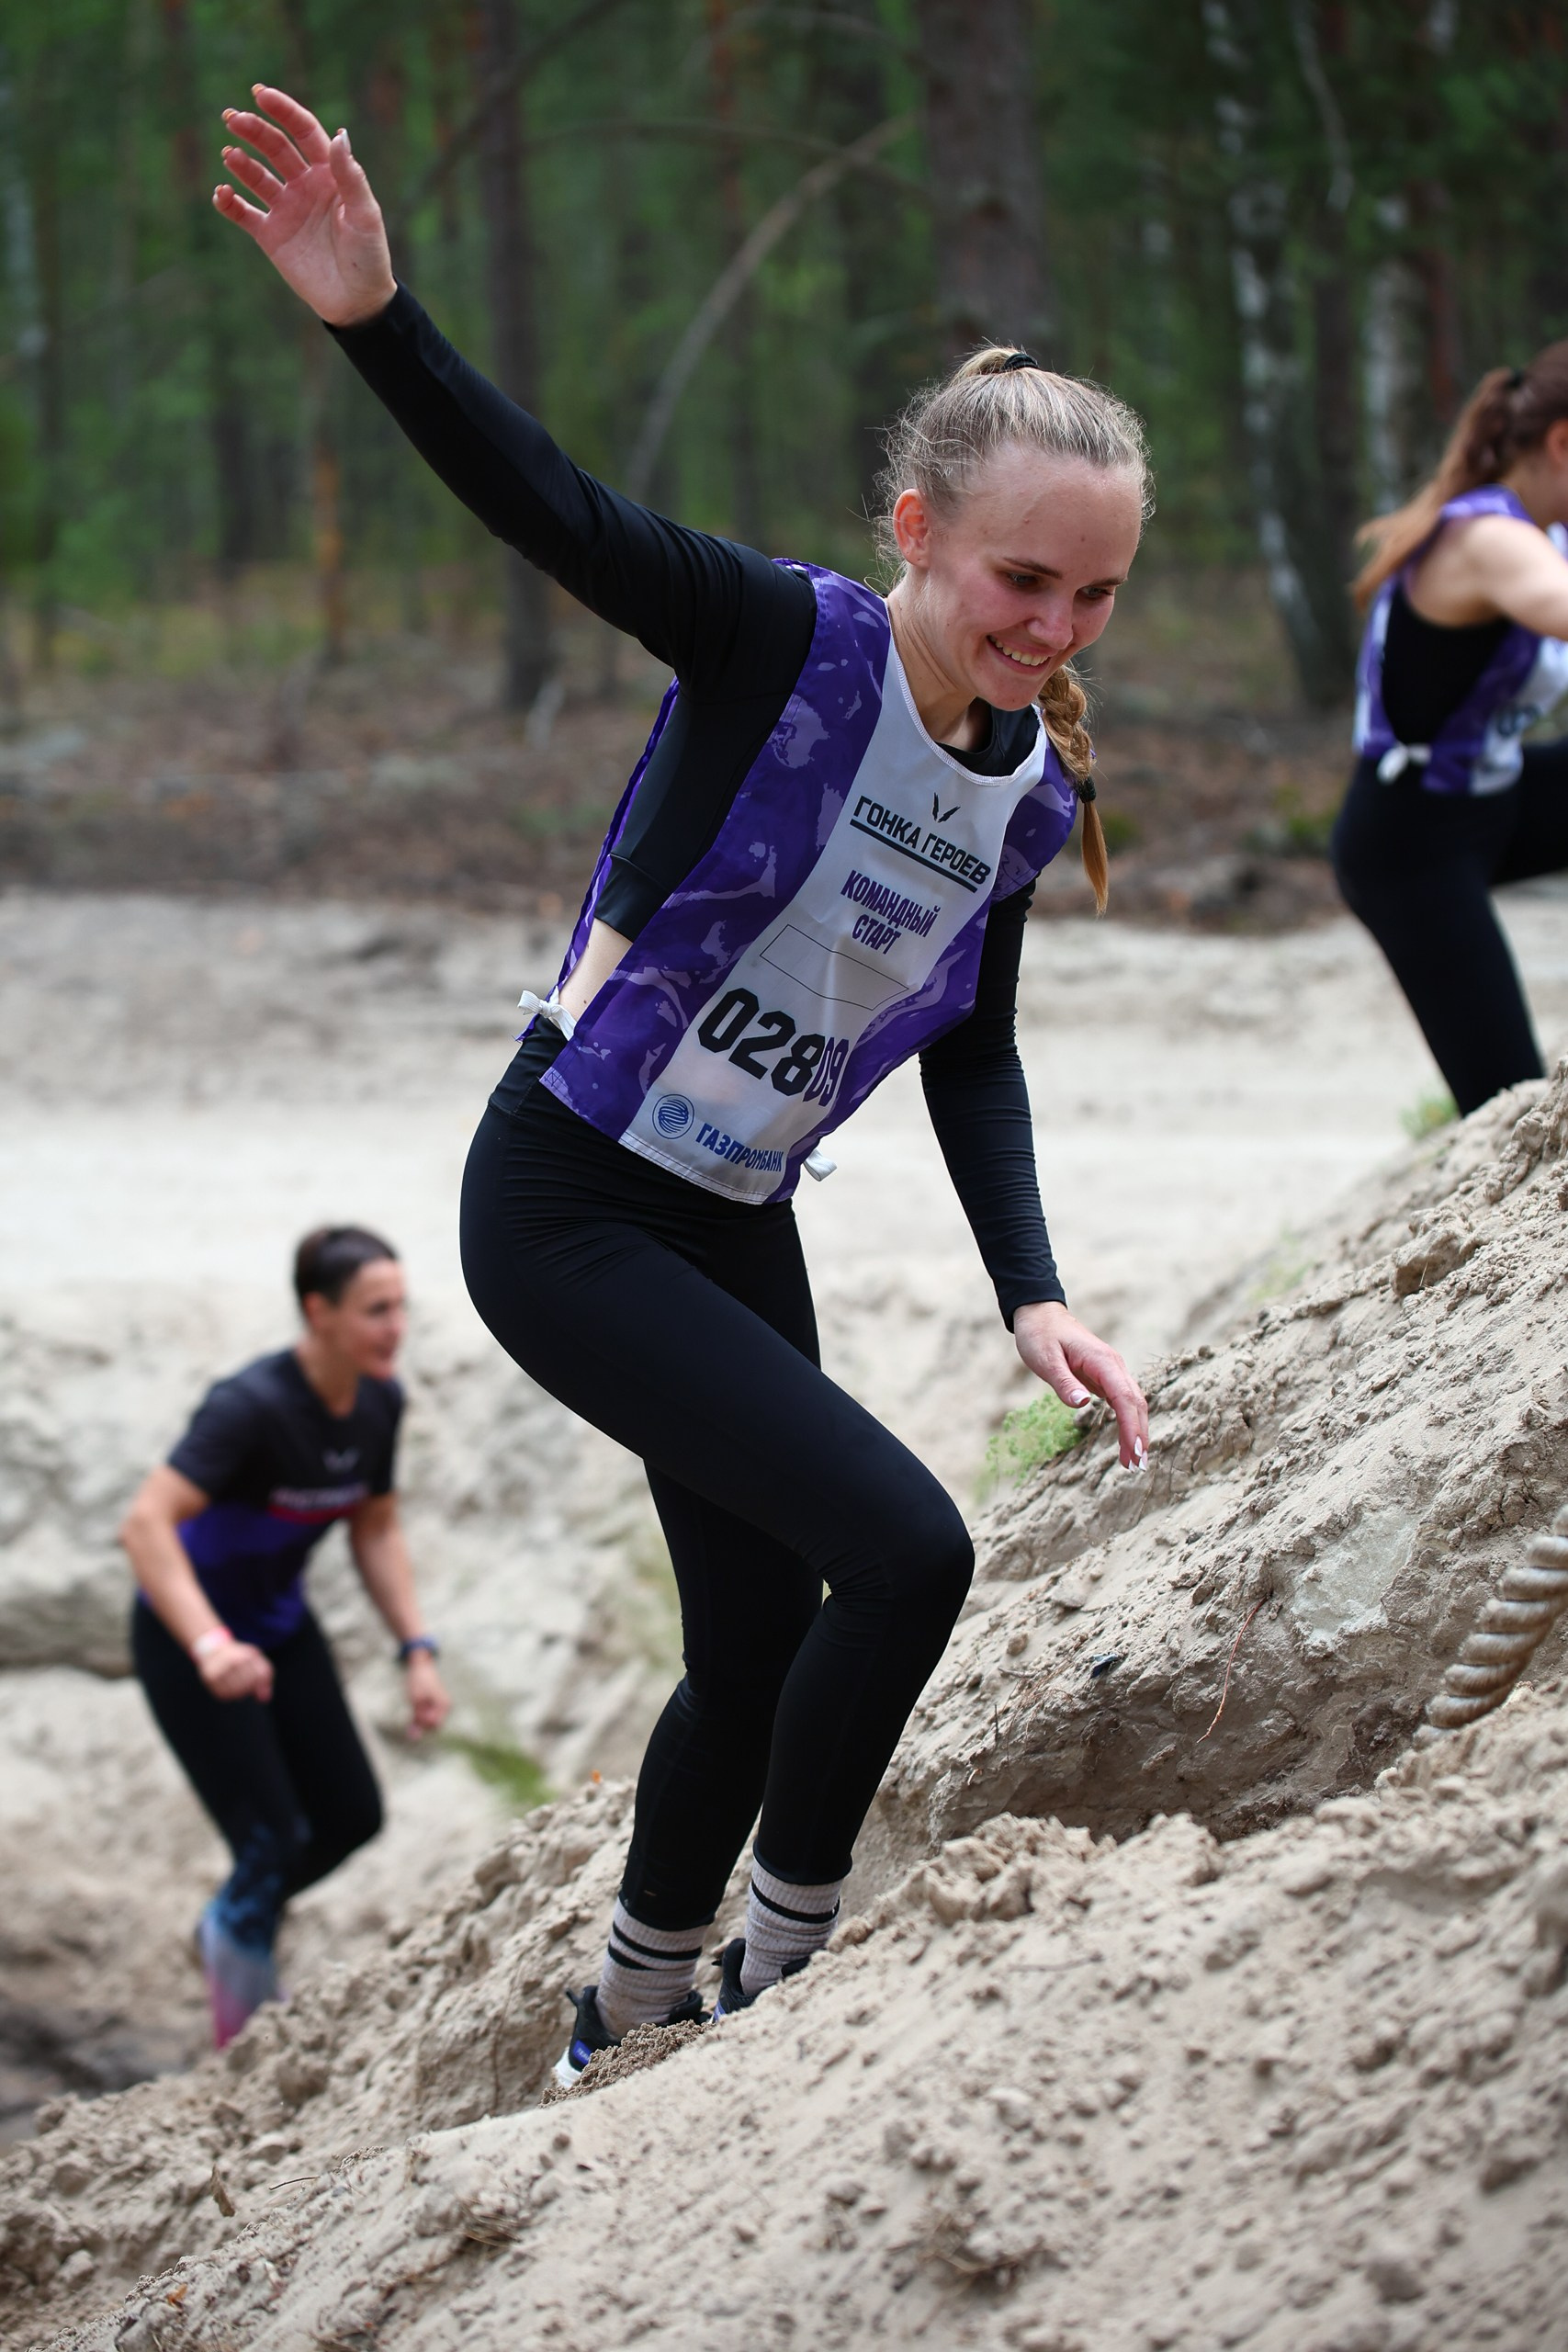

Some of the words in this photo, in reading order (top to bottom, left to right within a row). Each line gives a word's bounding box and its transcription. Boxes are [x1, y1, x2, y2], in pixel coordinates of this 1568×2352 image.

[853, 796, 921, 849] ГОНКА
[921, 832, 991, 885] ГЕРОЕВ
[840, 869, 941, 938] КОМАНДНЫЙ
[852, 913, 902, 955] СТАРТ
[695, 1123, 784, 1172] ГАЗПРОМБАНК
